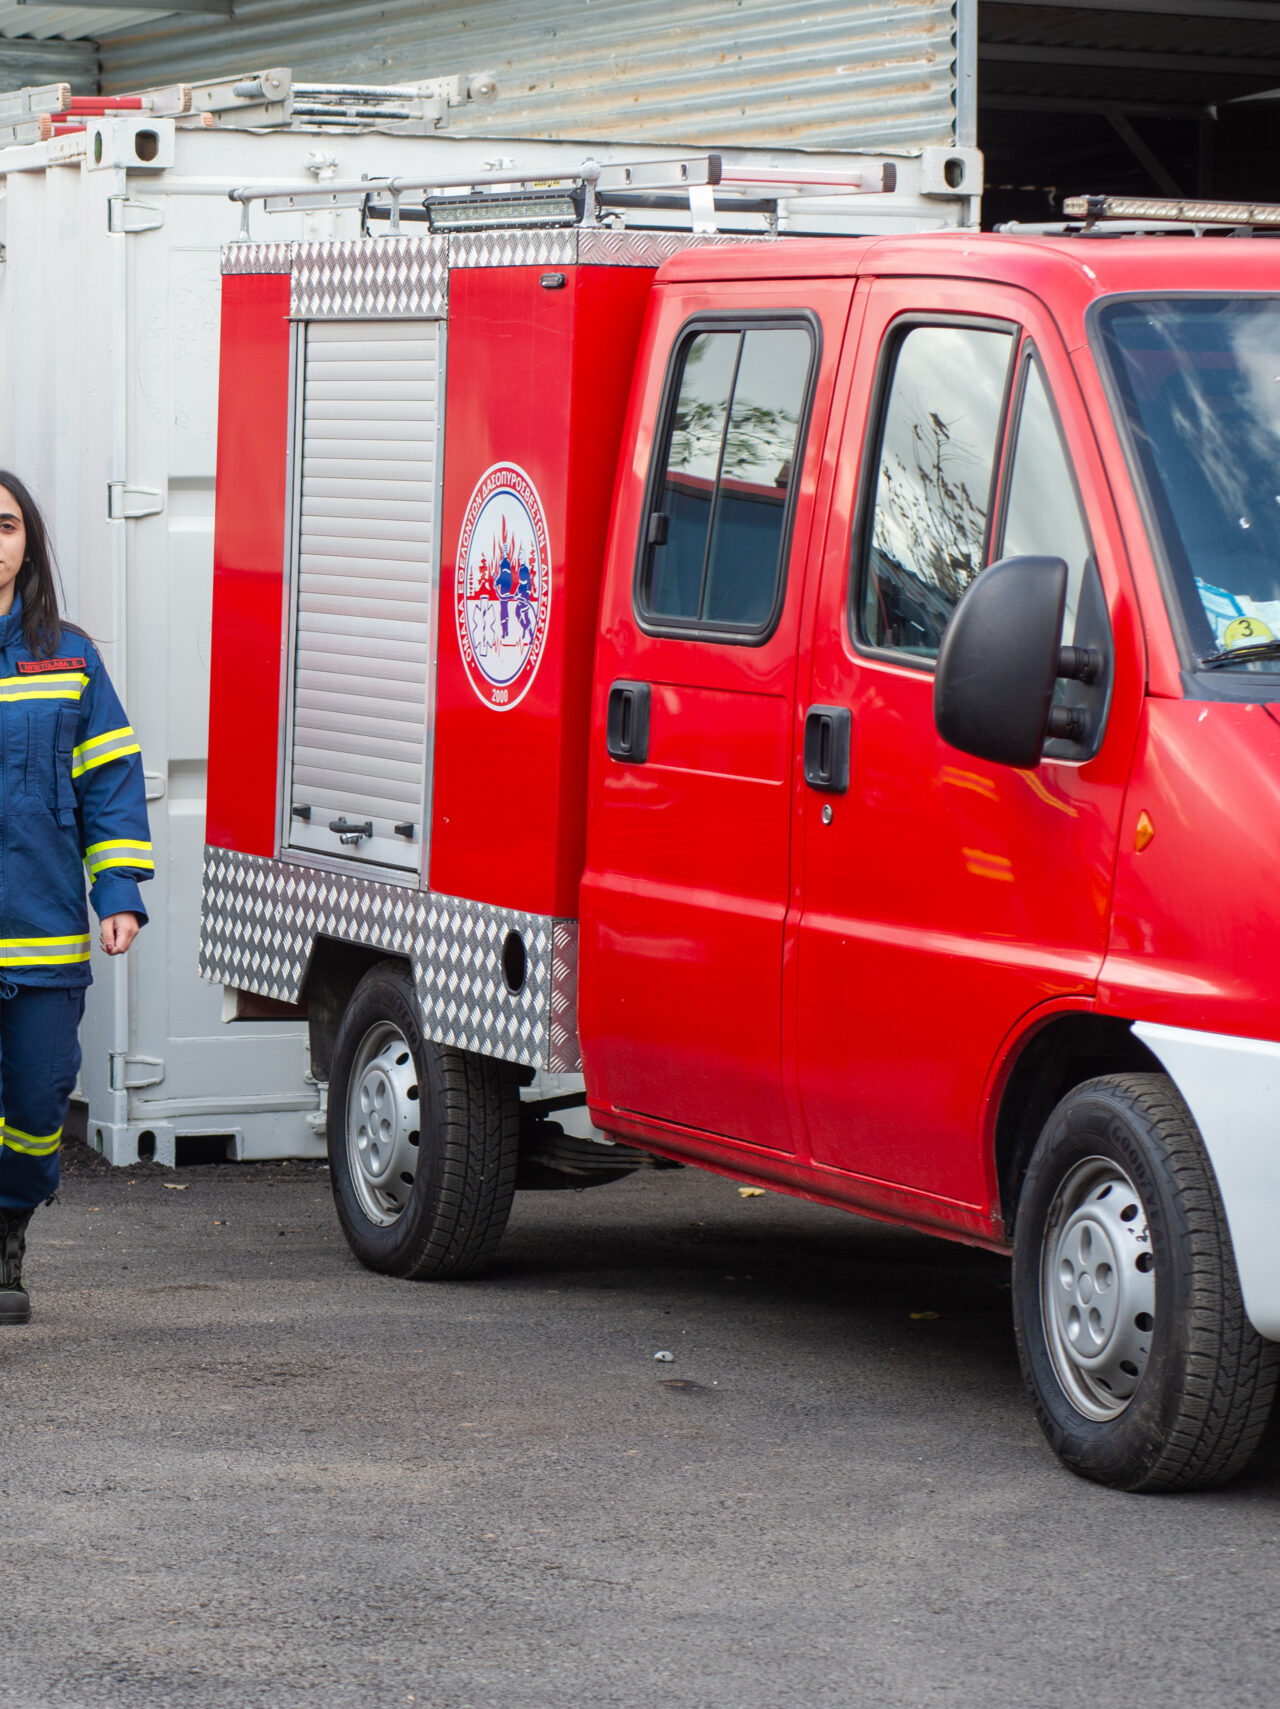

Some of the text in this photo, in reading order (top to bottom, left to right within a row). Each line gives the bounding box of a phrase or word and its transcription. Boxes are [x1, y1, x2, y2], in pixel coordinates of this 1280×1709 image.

[457, 492, 483, 594] ΕΘΕΛΟΝΤΩΝ
[481, 471, 546, 547] ΔΑΣΟΠΥΡΟΣΒΕΣΤΩΝ
[530, 566, 549, 667] ΔΙΑΣΩΣΤΩΝ
[1238, 619, 1253, 637] 3
[491, 688, 509, 703] 2000
